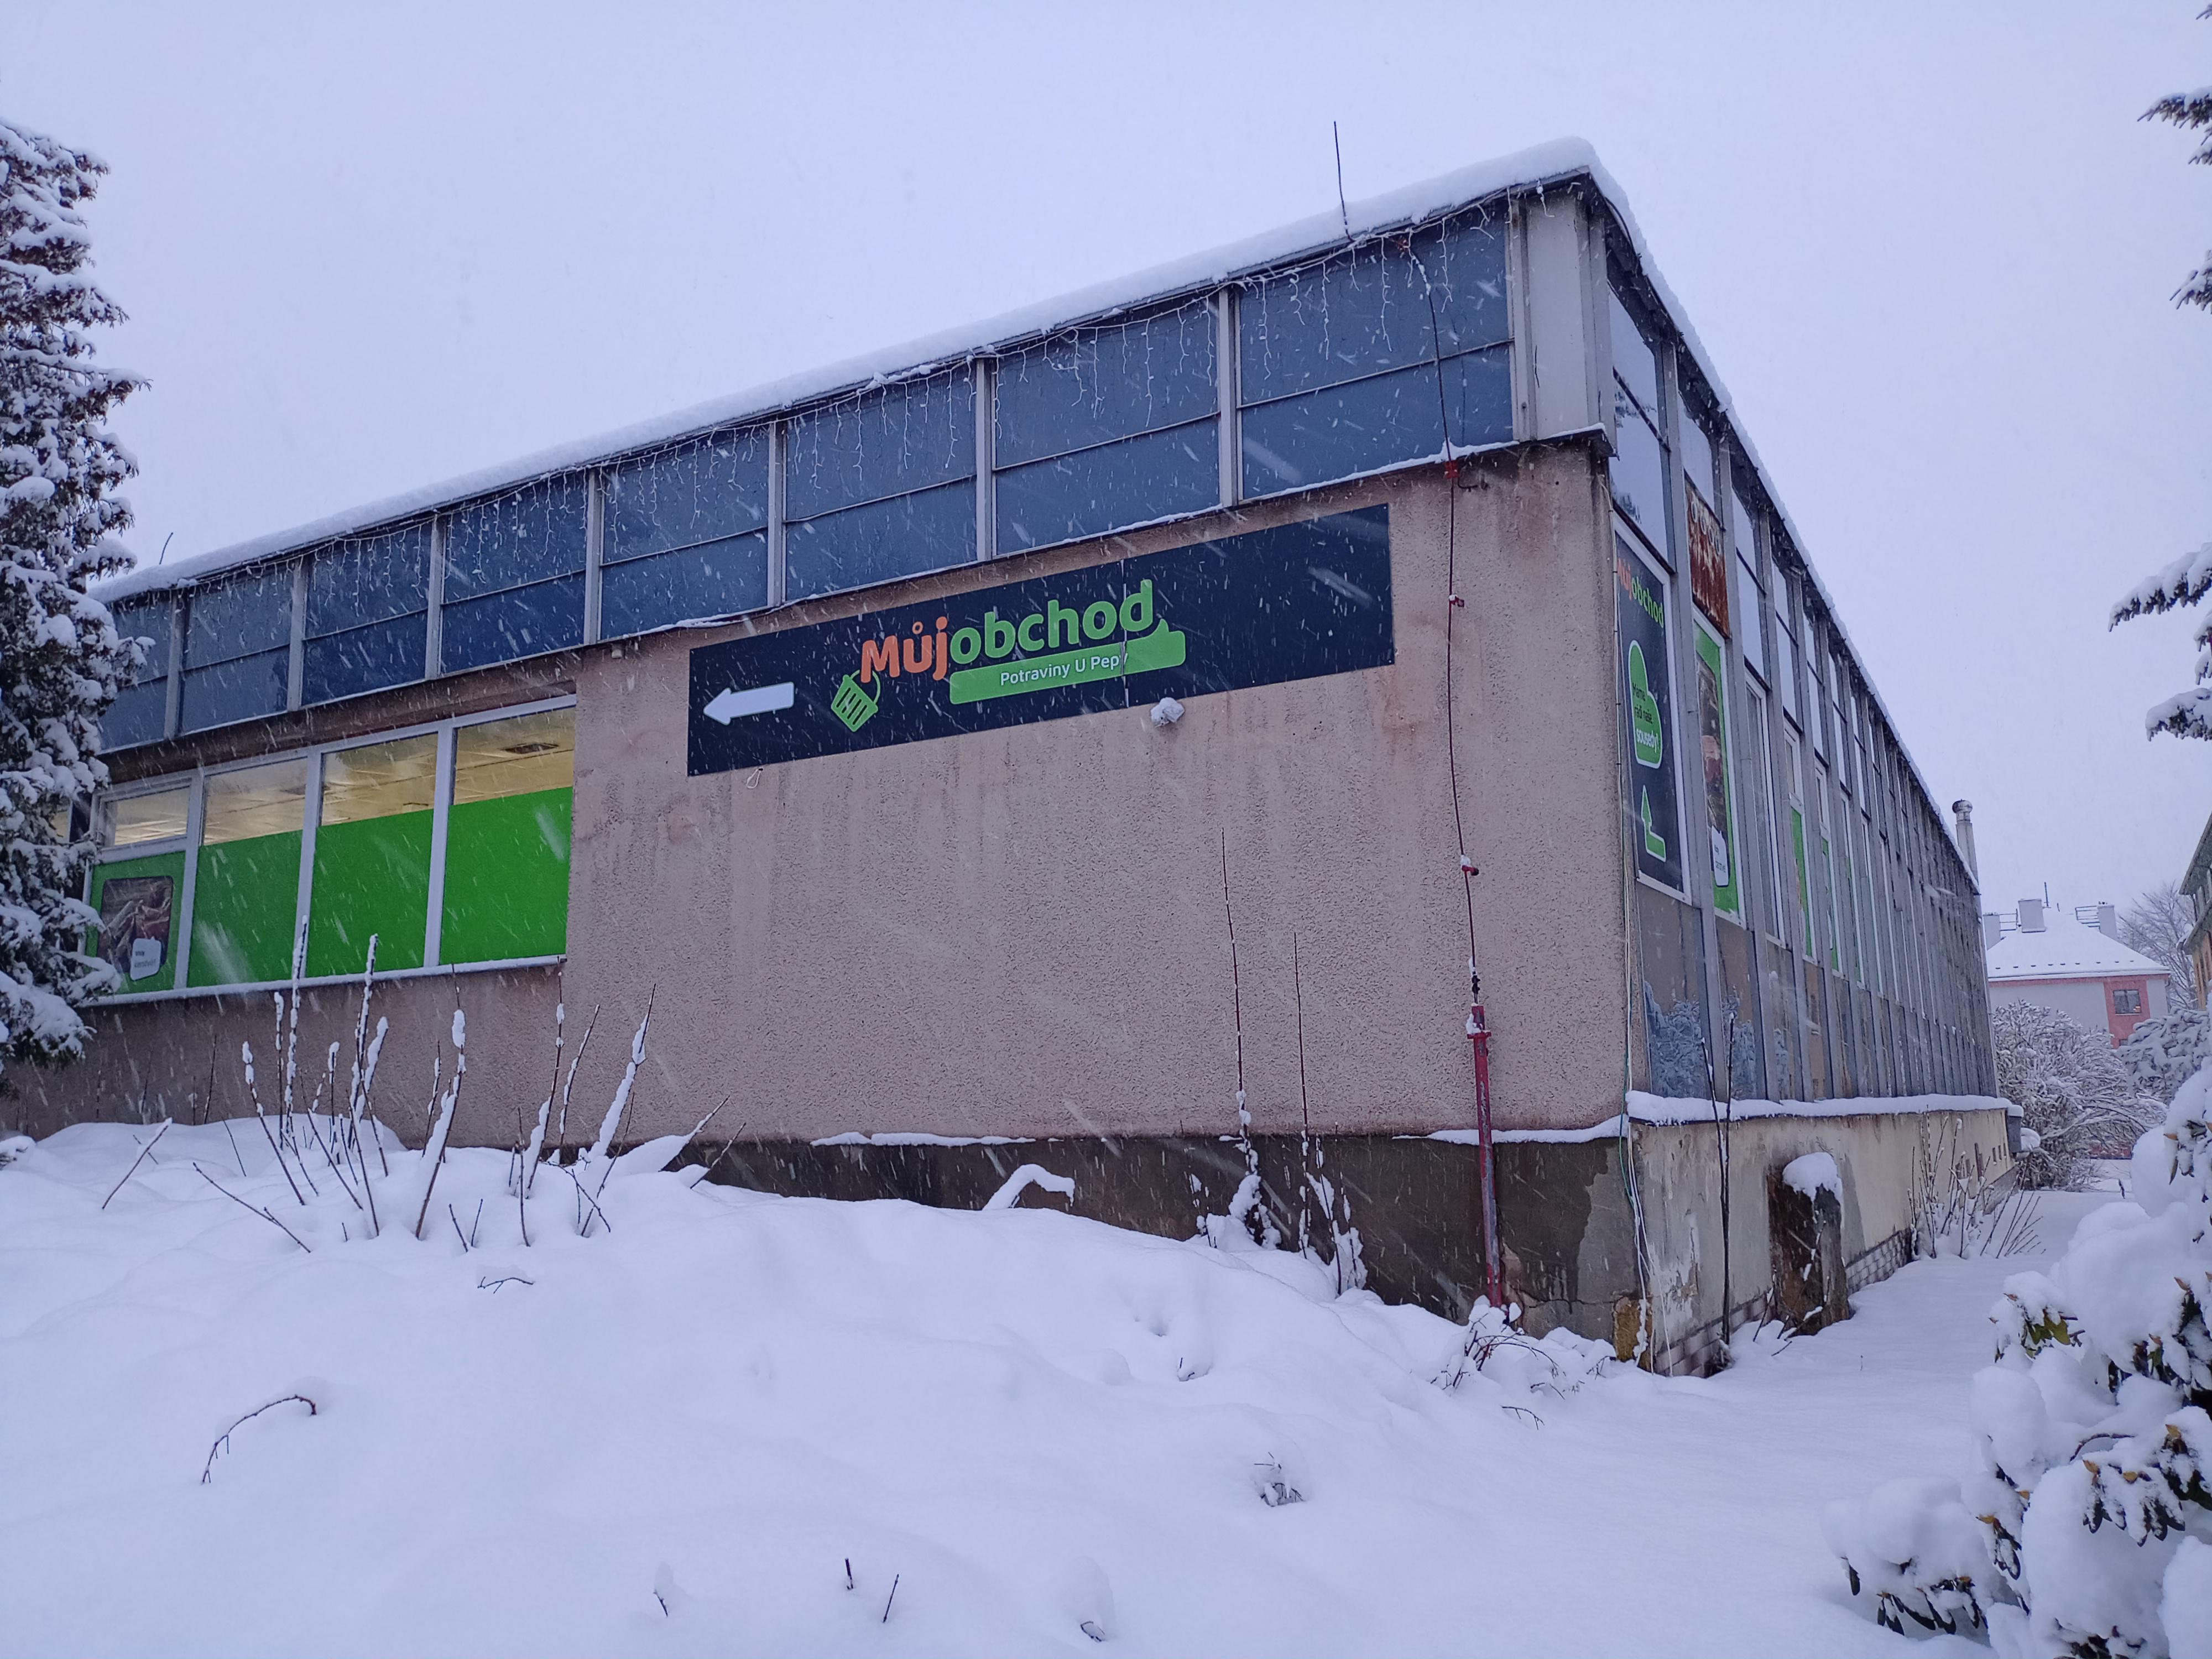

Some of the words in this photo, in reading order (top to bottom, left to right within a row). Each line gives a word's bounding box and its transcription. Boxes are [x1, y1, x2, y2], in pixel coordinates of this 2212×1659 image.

[860, 578, 1153, 684] Můjobchod
[1000, 664, 1070, 686] Potraviny
[1075, 658, 1086, 672] U
